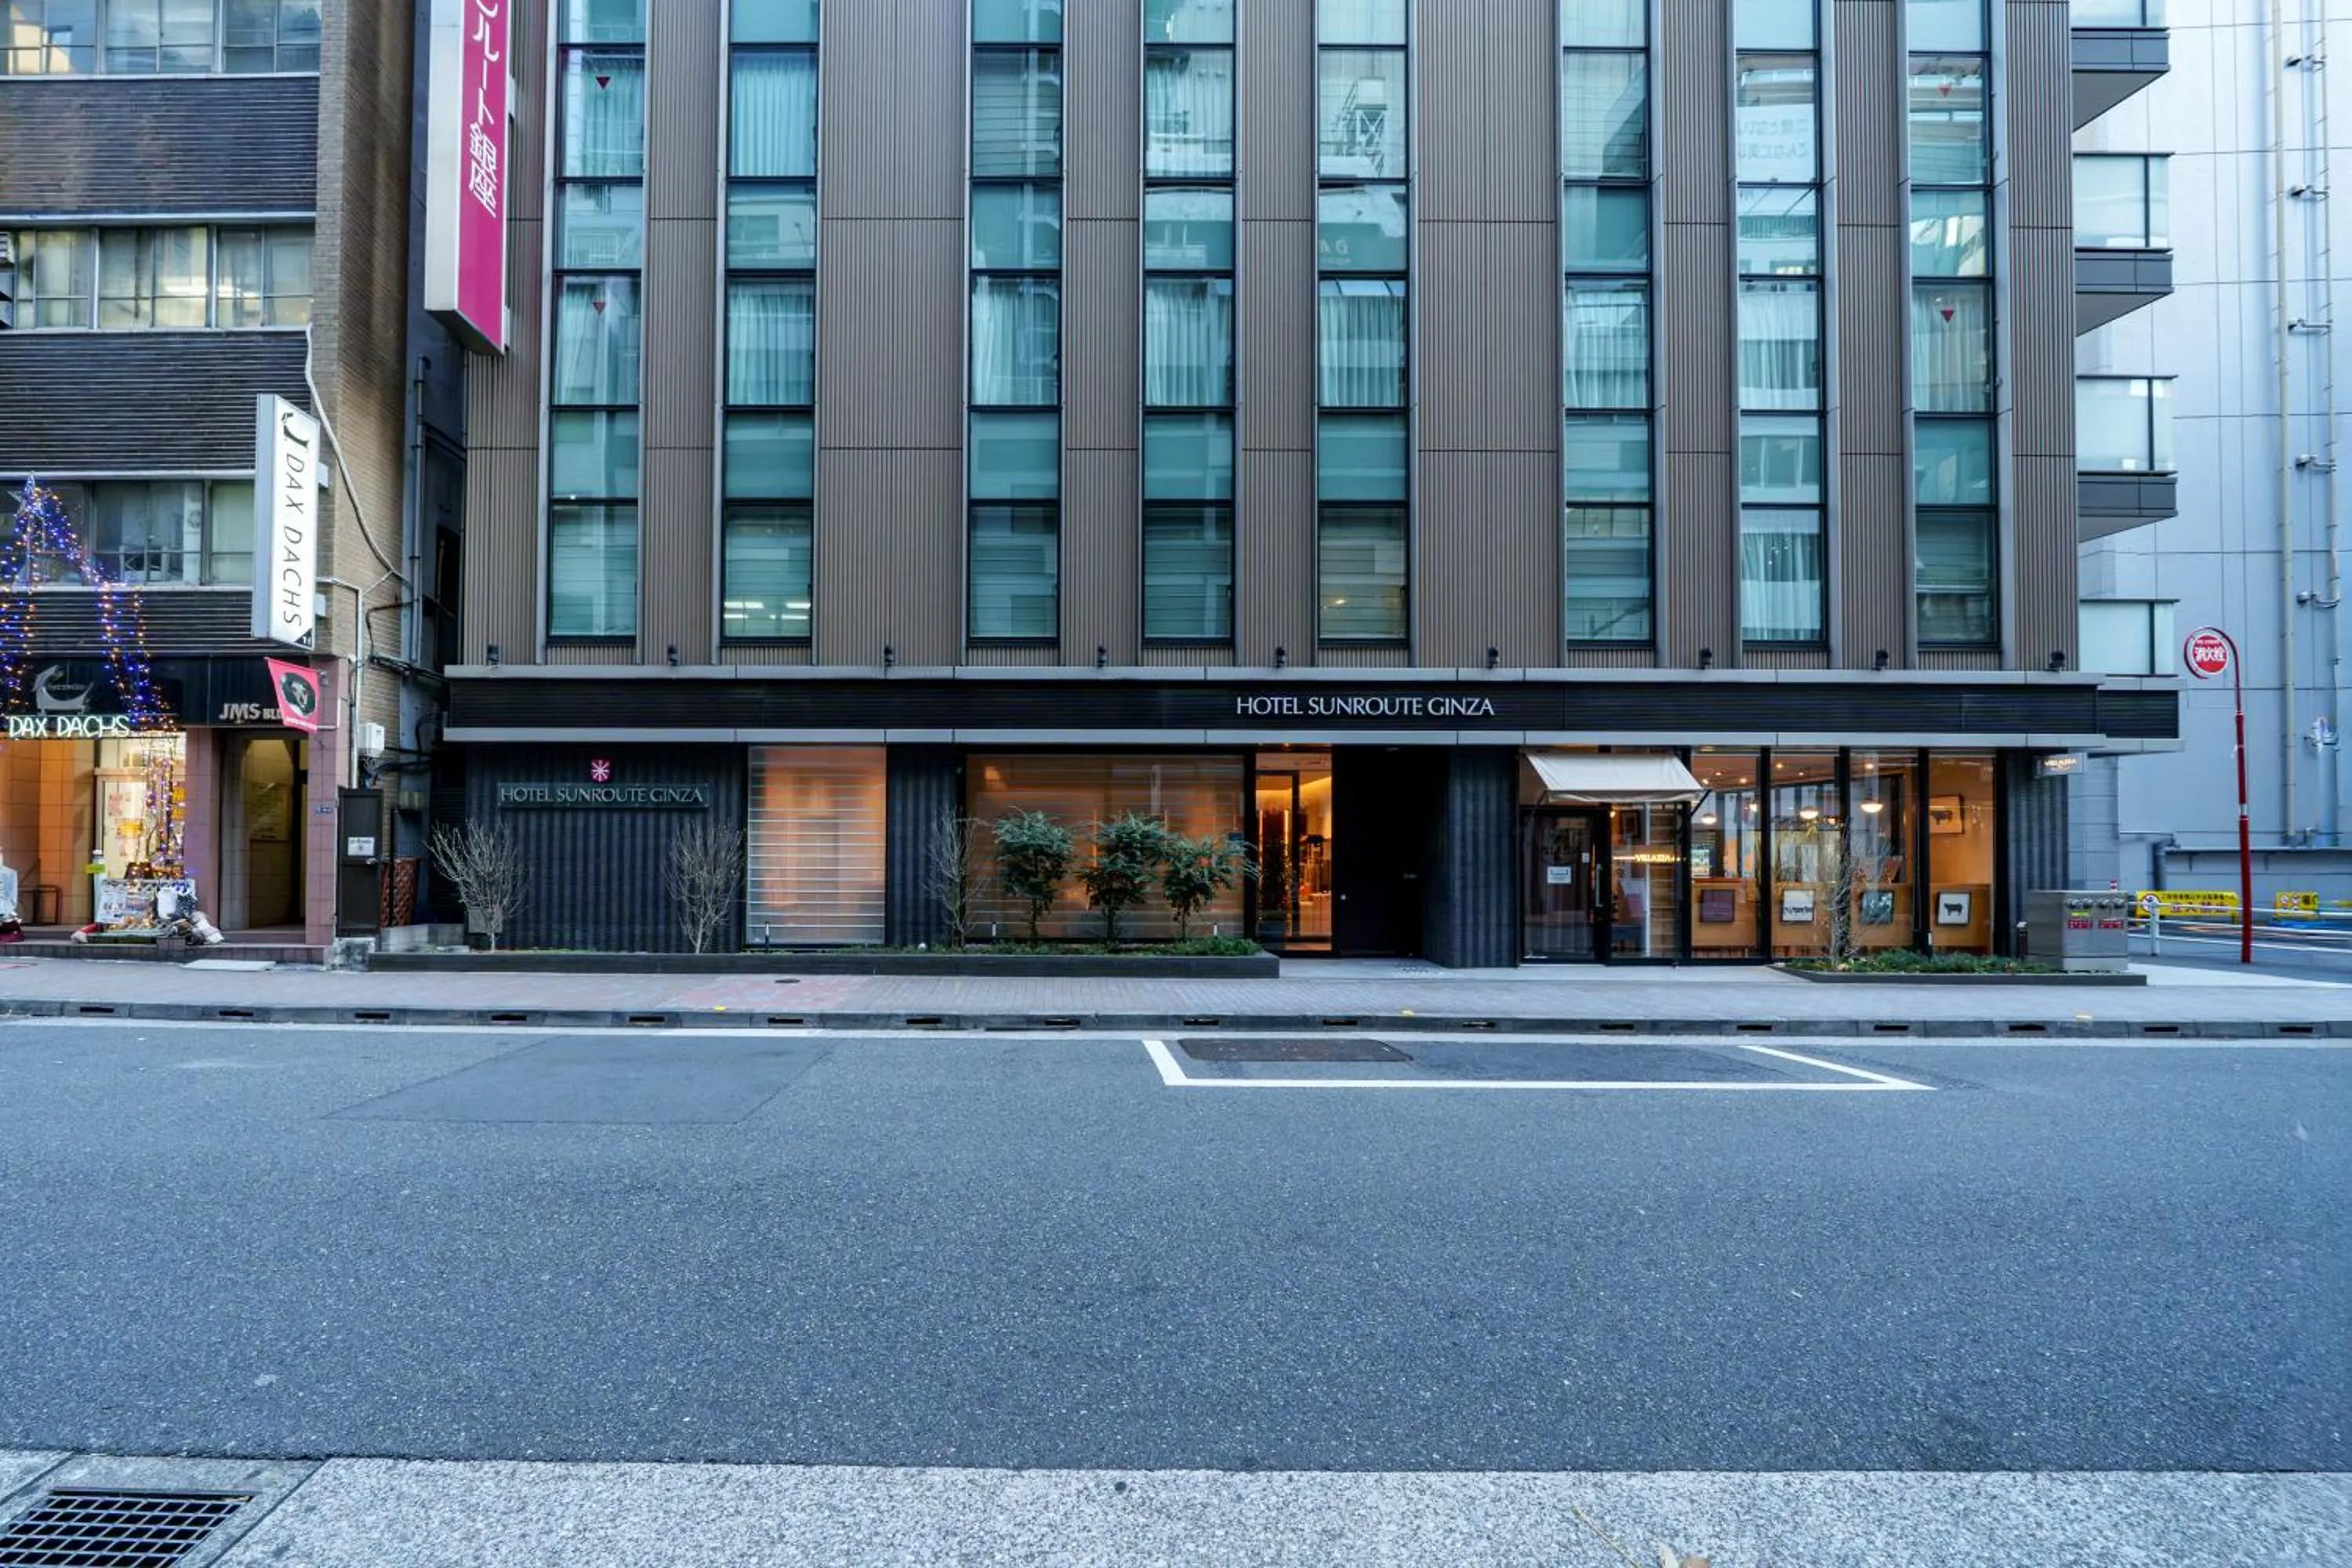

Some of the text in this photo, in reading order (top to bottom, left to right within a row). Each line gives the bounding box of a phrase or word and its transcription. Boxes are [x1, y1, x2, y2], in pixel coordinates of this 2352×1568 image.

[282, 452, 305, 626] DAX DACHS
[220, 703, 261, 720] JMS
[1236, 697, 1494, 716] HOTEL SUNROUTE GINZA
[9, 715, 130, 738] DAX DACHS
[500, 787, 703, 803] HOTEL SUNROUTE GINZA
